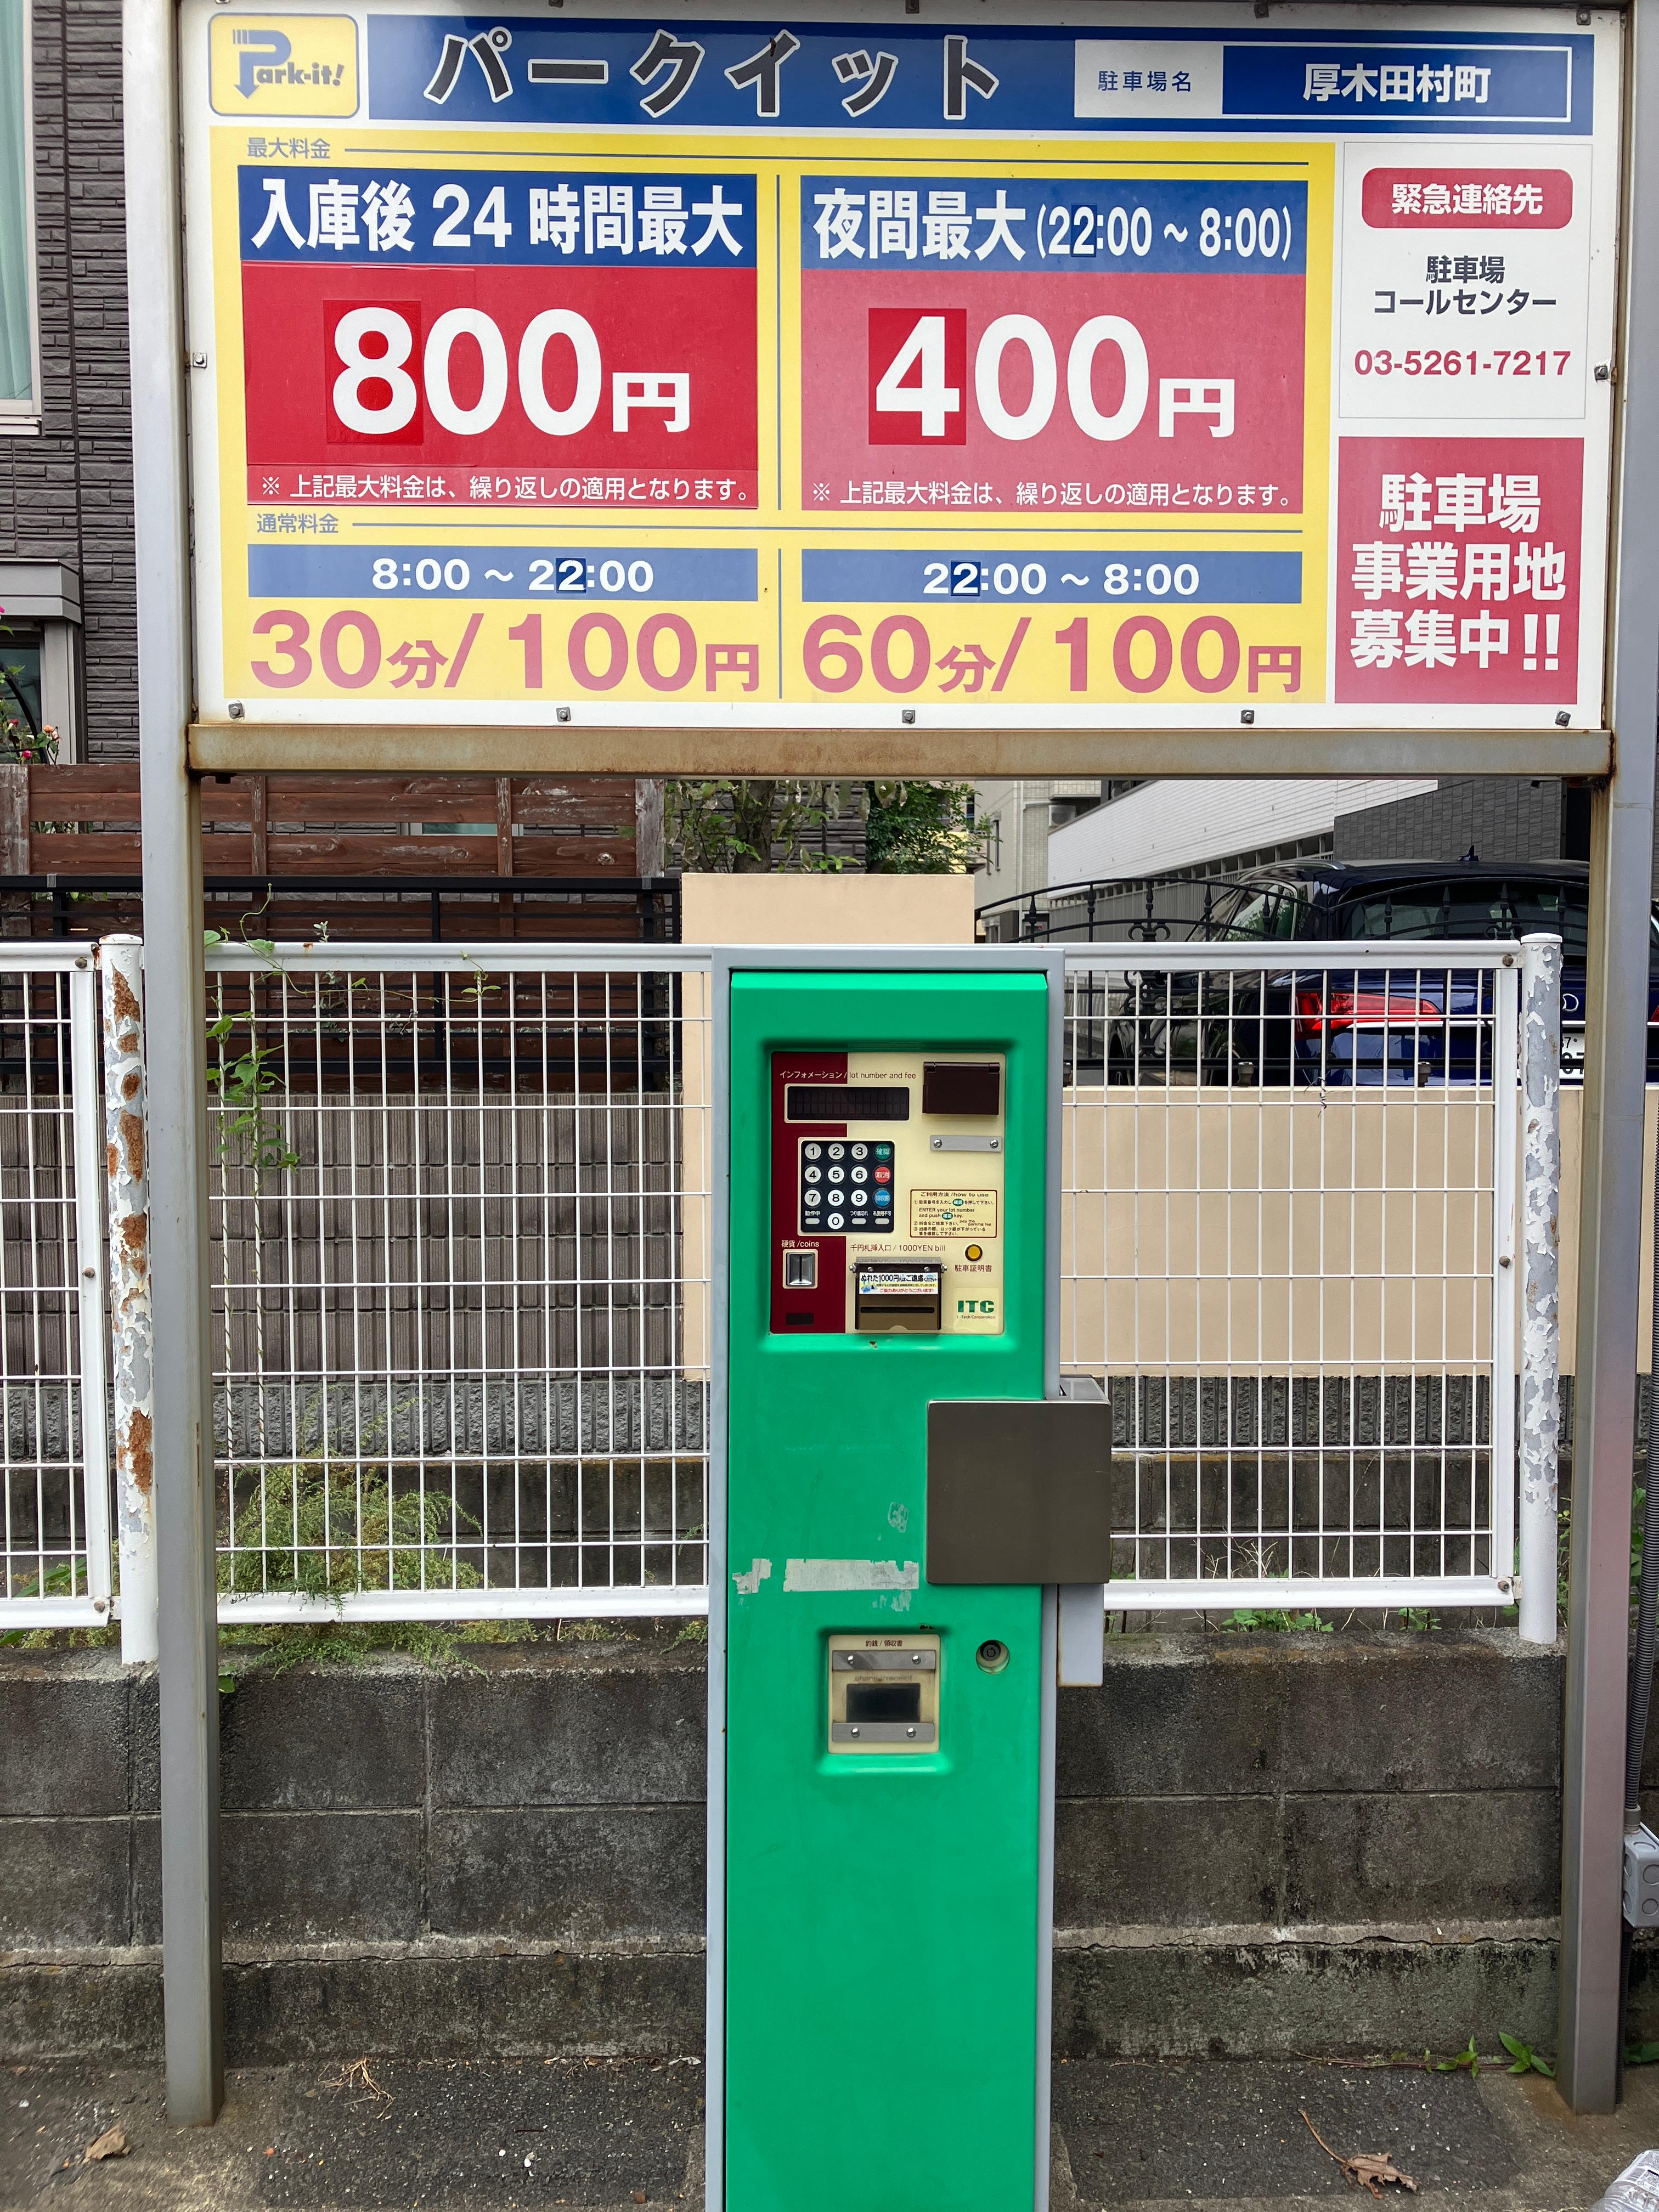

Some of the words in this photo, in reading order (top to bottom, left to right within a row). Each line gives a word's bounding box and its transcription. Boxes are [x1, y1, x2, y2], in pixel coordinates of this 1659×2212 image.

[233, 29, 345, 99] Park-it!
[423, 26, 999, 120] パークイット
[1098, 70, 1191, 92] 駐車場名
[1303, 63, 1491, 103] 厚木田村町
[247, 137, 330, 159] 最大料金
[1392, 184, 1543, 215] 緊急連絡先
[1426, 255, 1505, 284] 駐車場
[1374, 289, 1556, 315] コールセンター
[332, 306, 690, 436] 800円
[875, 314, 1235, 441] 400円
[1355, 350, 1571, 376] 03-5261-7217
[1379, 472, 1541, 533] 駐車場
[257, 513, 338, 533] 通常料金
[372, 558, 470, 590] 8:00
[528, 559, 653, 592] 22:00
[923, 562, 1046, 595] 22:00
[1103, 563, 1200, 595] 8:00
[1351, 540, 1566, 601] 事業用地
[250, 610, 760, 692] 30分/100円
[803, 614, 1301, 693] 60分/100円
[810, 1147, 815, 1155] 1
[833, 1147, 840, 1155] 2
[856, 1147, 863, 1155] 3
[832, 1171, 839, 1179] 5
[856, 1171, 863, 1179] 6
[809, 1194, 816, 1202] 7
[832, 1194, 839, 1202] 8
[855, 1194, 862, 1202] 9
[832, 1217, 839, 1225] 0
[958, 1300, 994, 1313] ITC
